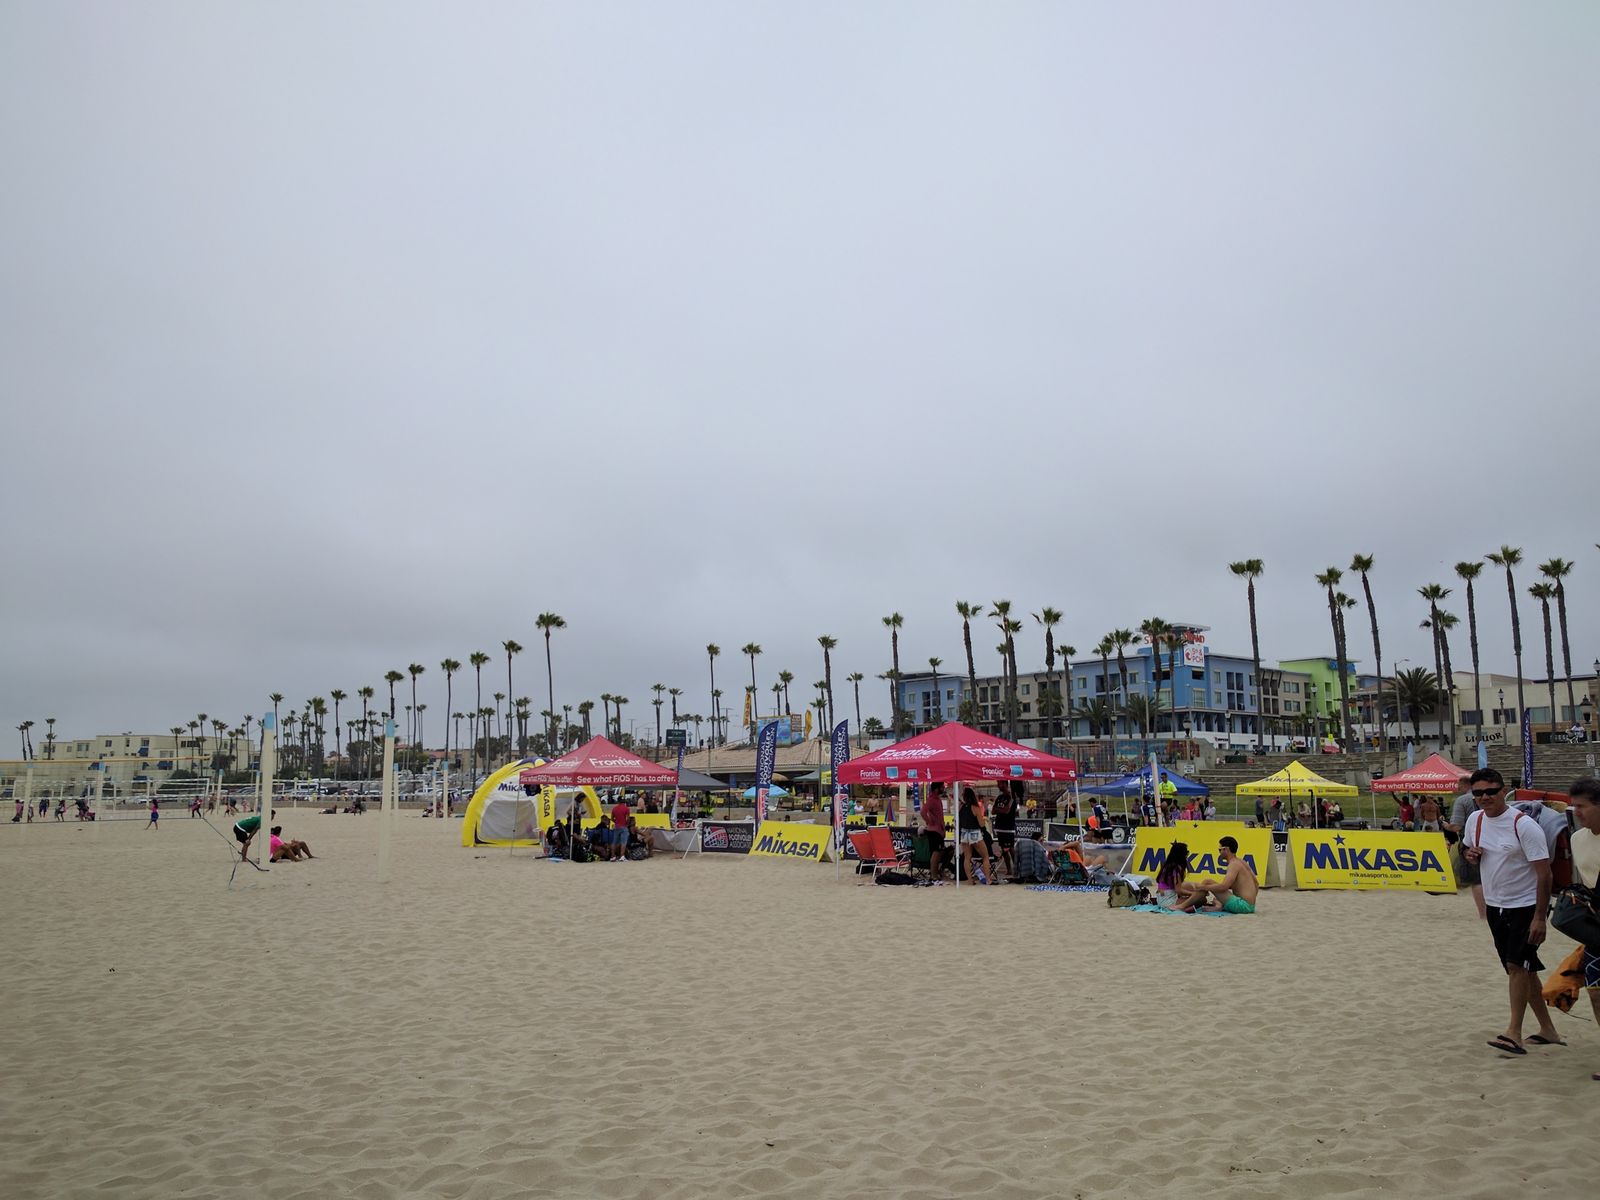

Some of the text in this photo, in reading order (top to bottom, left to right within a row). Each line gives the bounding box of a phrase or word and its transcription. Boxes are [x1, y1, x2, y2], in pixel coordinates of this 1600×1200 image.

[1465, 732, 1503, 742] LIUOR
[960, 745, 1034, 757] Frontier
[588, 757, 641, 767] Frontier
[860, 769, 881, 777] Frontier
[981, 767, 1005, 775] Frontier
[577, 775, 591, 783] See
[593, 775, 613, 783] what
[755, 834, 819, 858] MIKASA
[1139, 847, 1258, 875] MKASA
[1304, 841, 1444, 872] MIKASA
